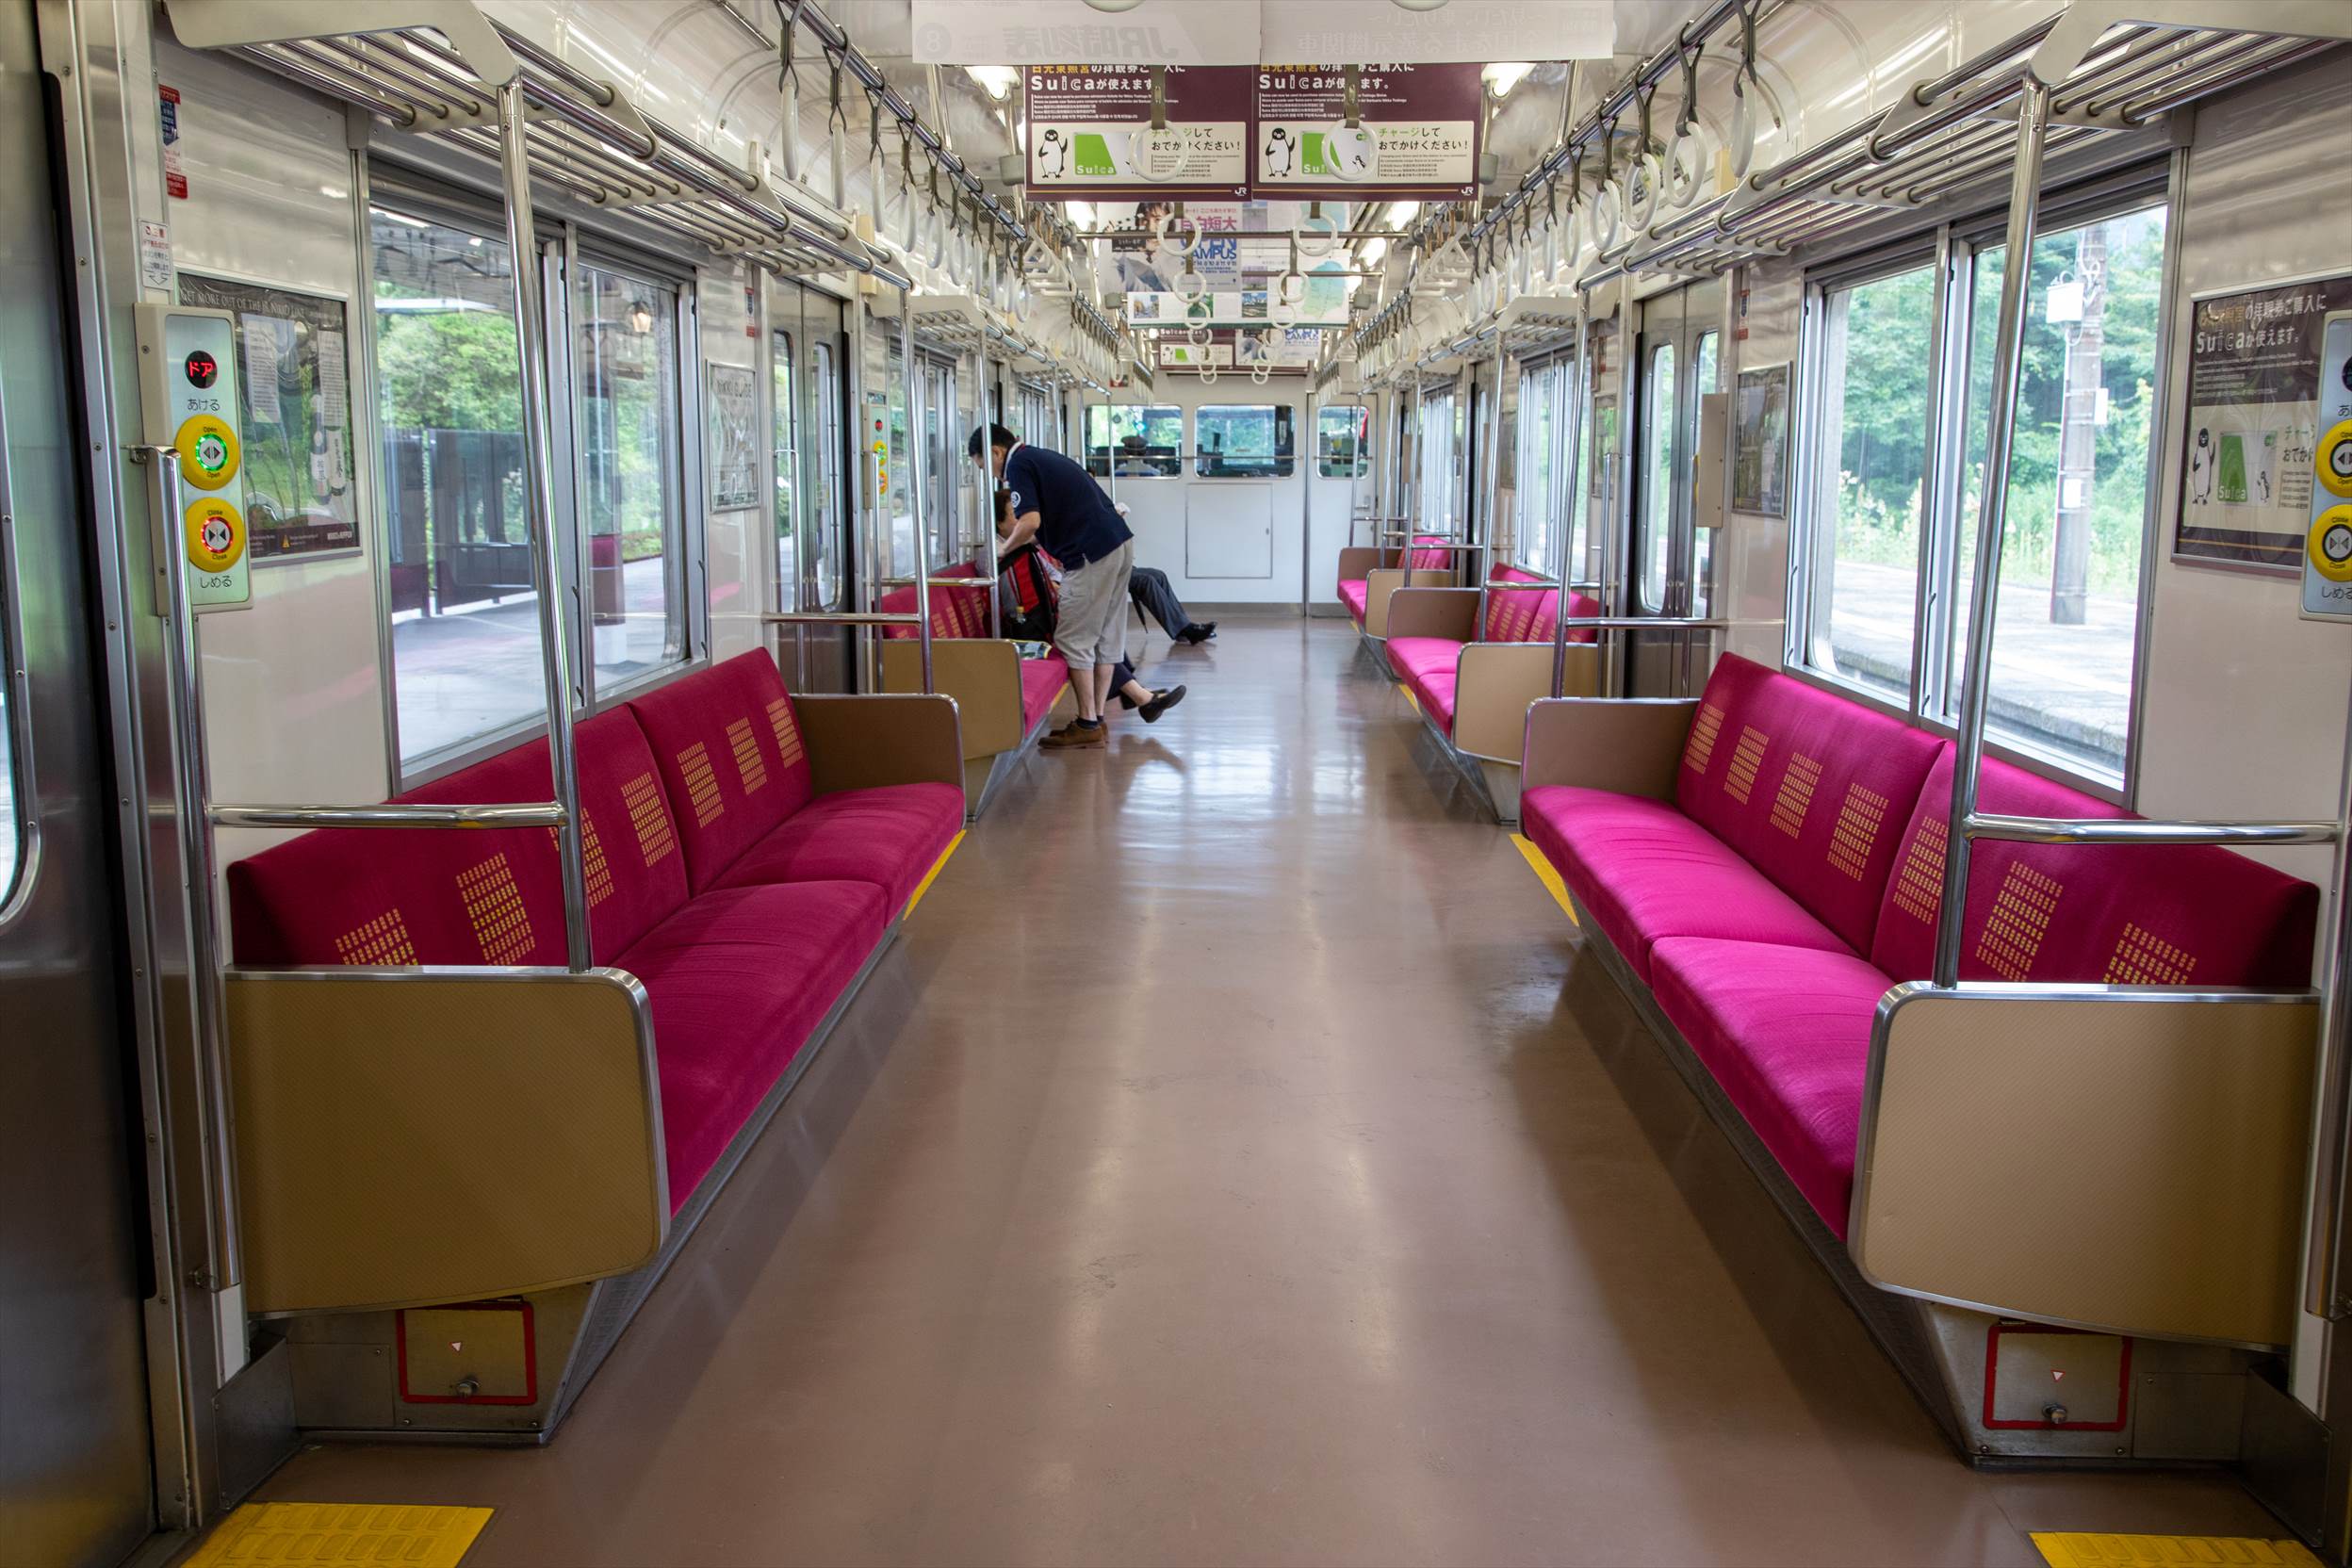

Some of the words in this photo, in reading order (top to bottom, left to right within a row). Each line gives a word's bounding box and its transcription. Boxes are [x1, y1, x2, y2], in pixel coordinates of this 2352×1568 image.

[1259, 74, 1389, 90] Suicaが使ます。
[1152, 127, 1214, 138] チャジして
[1379, 127, 1441, 138] チャージして
[1379, 140, 1468, 151] おでかけください！
[1076, 165, 1115, 174] Suica
[1181, 248, 1237, 260] AMPUS
[188, 361, 214, 377] ドア
[188, 399, 220, 412] あける
[200, 575, 233, 589] しめる
